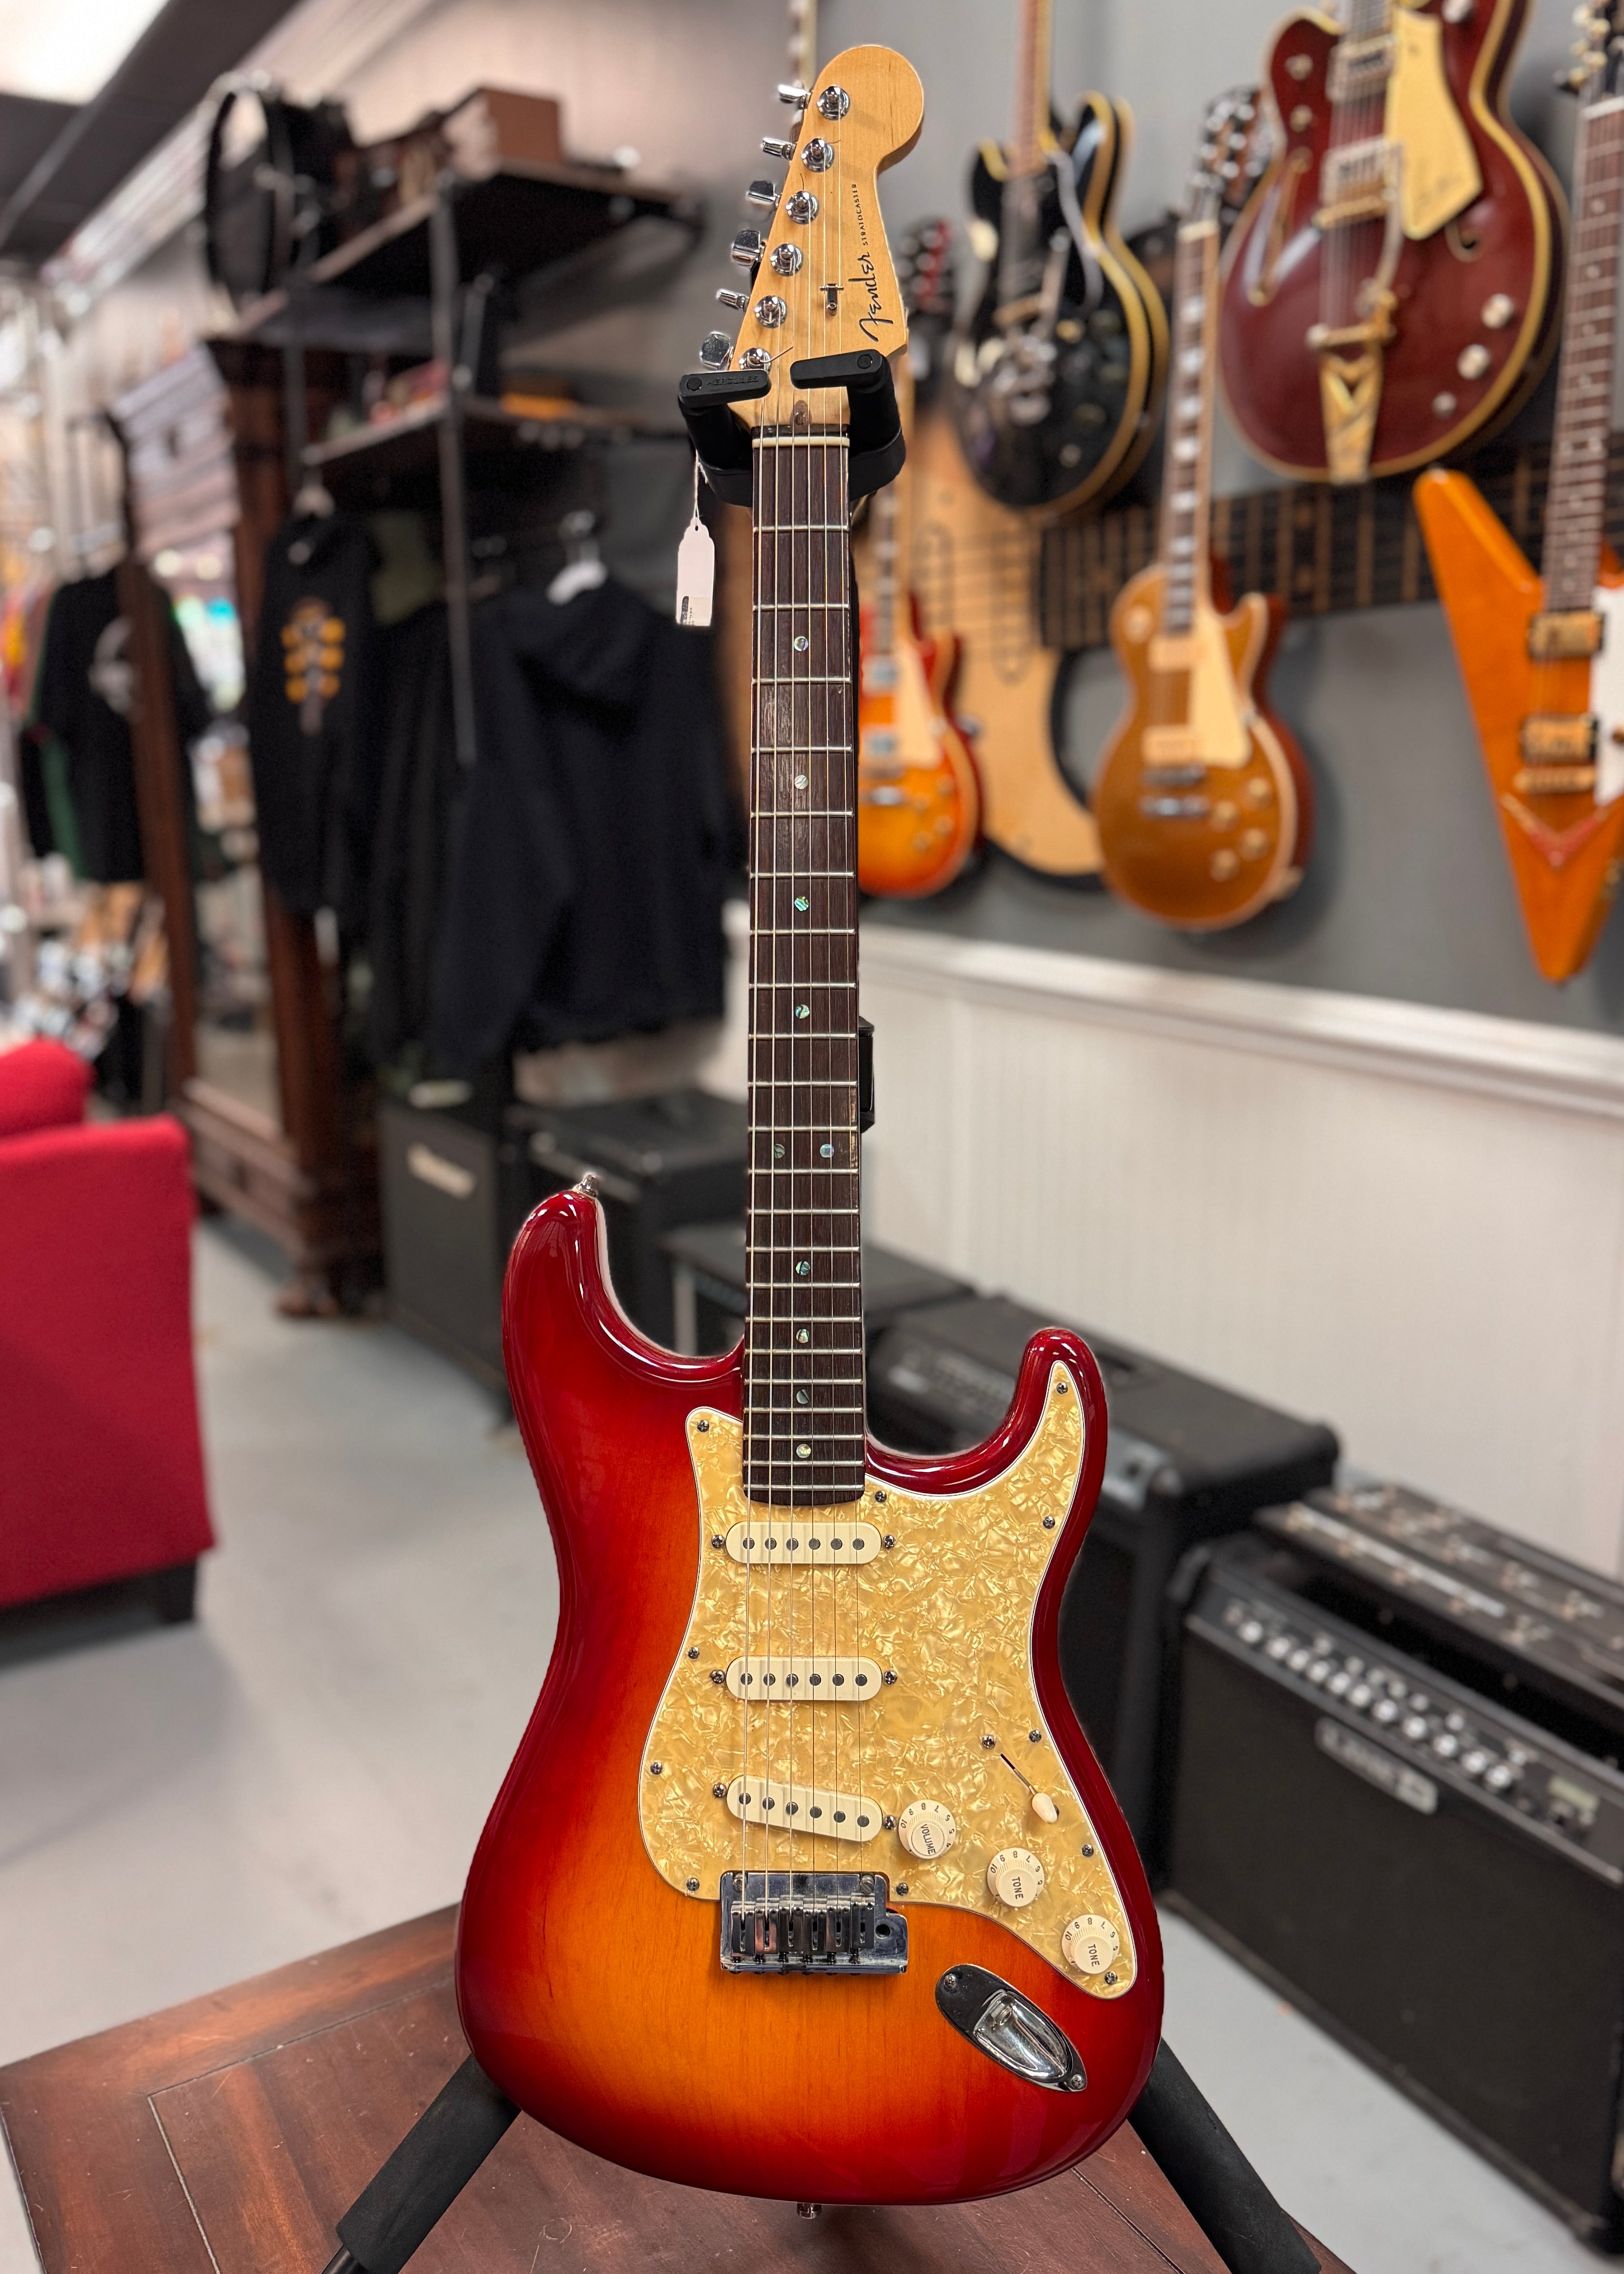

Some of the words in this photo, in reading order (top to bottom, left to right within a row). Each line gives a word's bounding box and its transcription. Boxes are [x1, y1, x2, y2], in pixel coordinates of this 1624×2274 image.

[852, 184, 868, 246] STRATOCASTER
[848, 252, 893, 341] Fender
[900, 1819, 907, 1828] 10
[921, 1824, 936, 1855] VOLUME
[990, 1864, 997, 1873] 10
[1012, 1876, 1023, 1899] TONE
[1087, 1917, 1092, 1925] 8
[1065, 1931, 1072, 1941] 10
[1088, 1944, 1100, 1967] TONE
